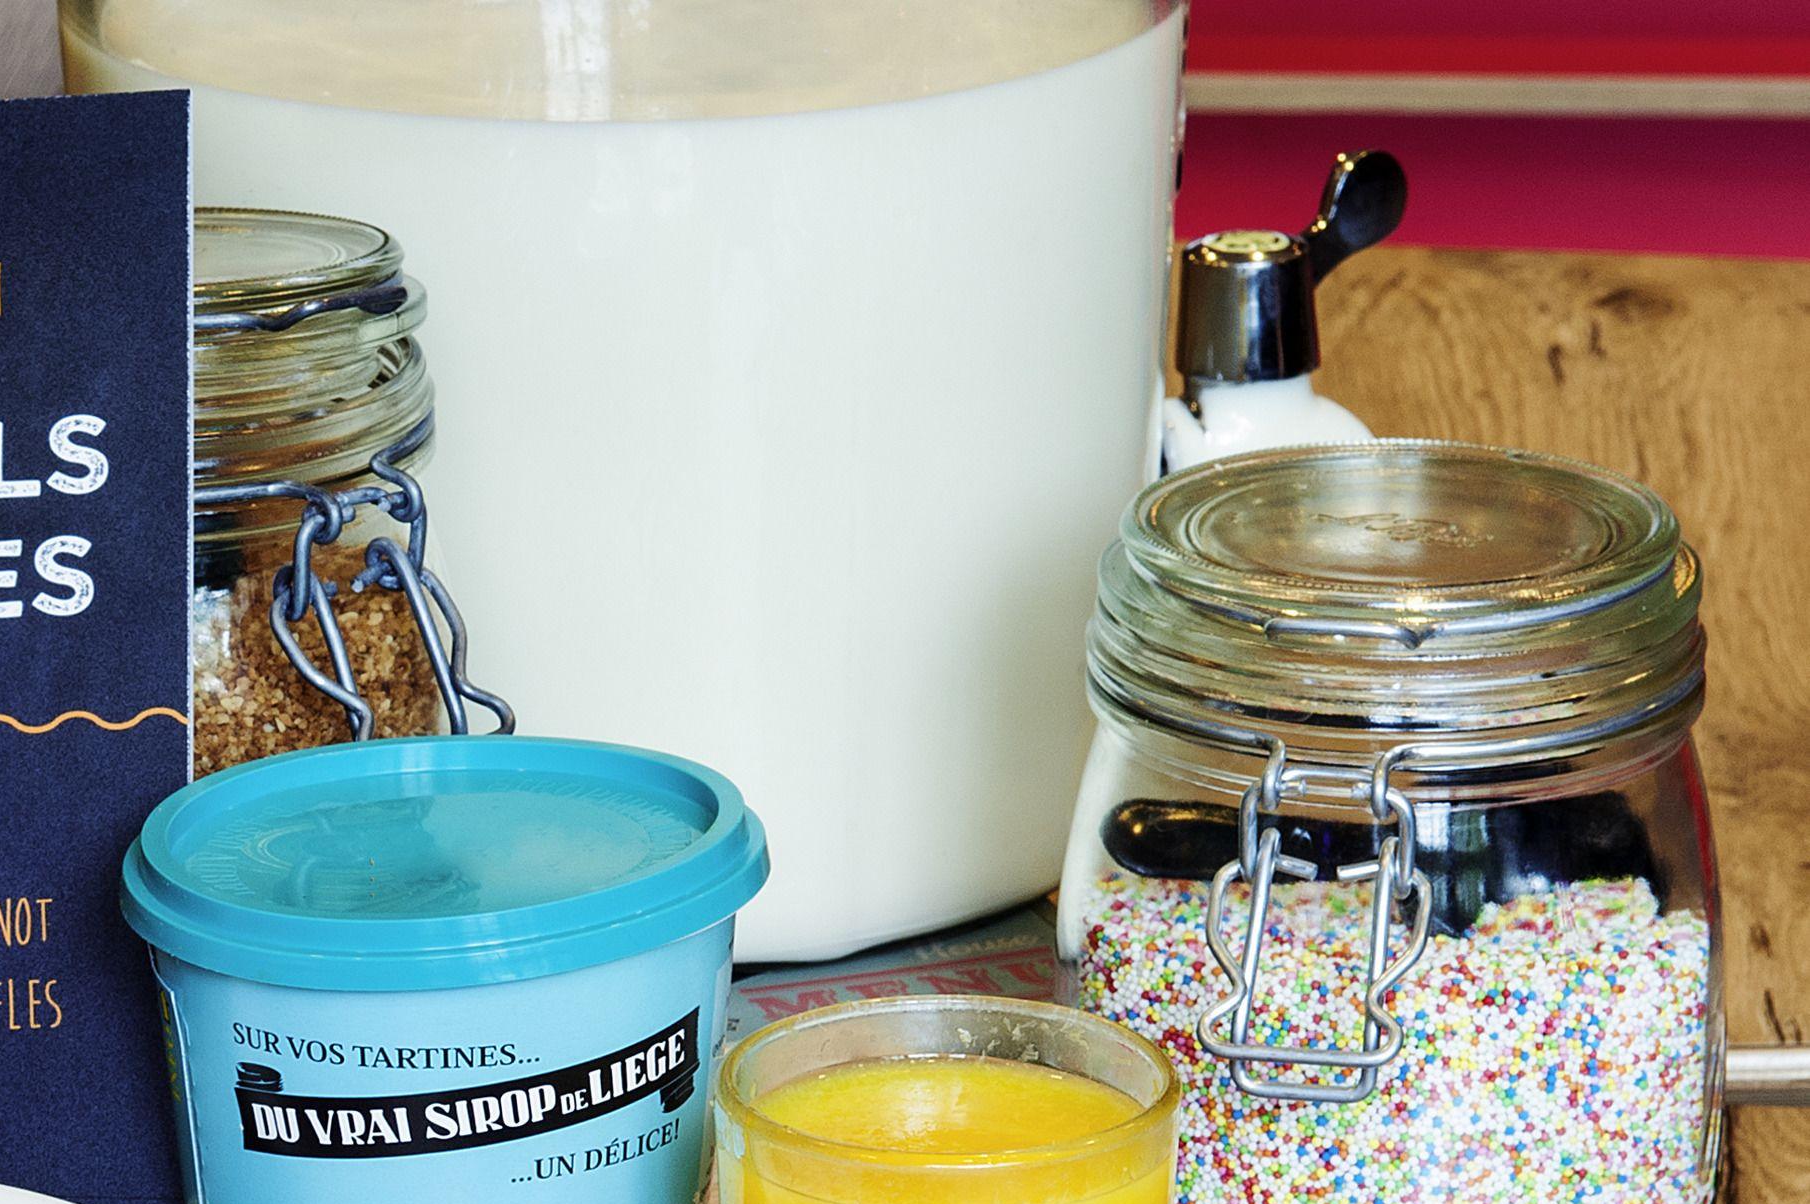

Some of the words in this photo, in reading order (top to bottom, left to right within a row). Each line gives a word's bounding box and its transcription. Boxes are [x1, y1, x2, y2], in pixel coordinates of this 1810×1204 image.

[232, 1022, 282, 1056] SUR
[285, 1036, 346, 1065] VOS
[351, 1042, 541, 1069] TARTINES...
[251, 1102, 301, 1144] DU
[304, 1106, 413, 1146] VRAI
[425, 1084, 557, 1141] SIROP
[559, 1088, 589, 1115] DE
[588, 1028, 686, 1106] LIEGE
[583, 1118, 681, 1172] DÉLICE!
